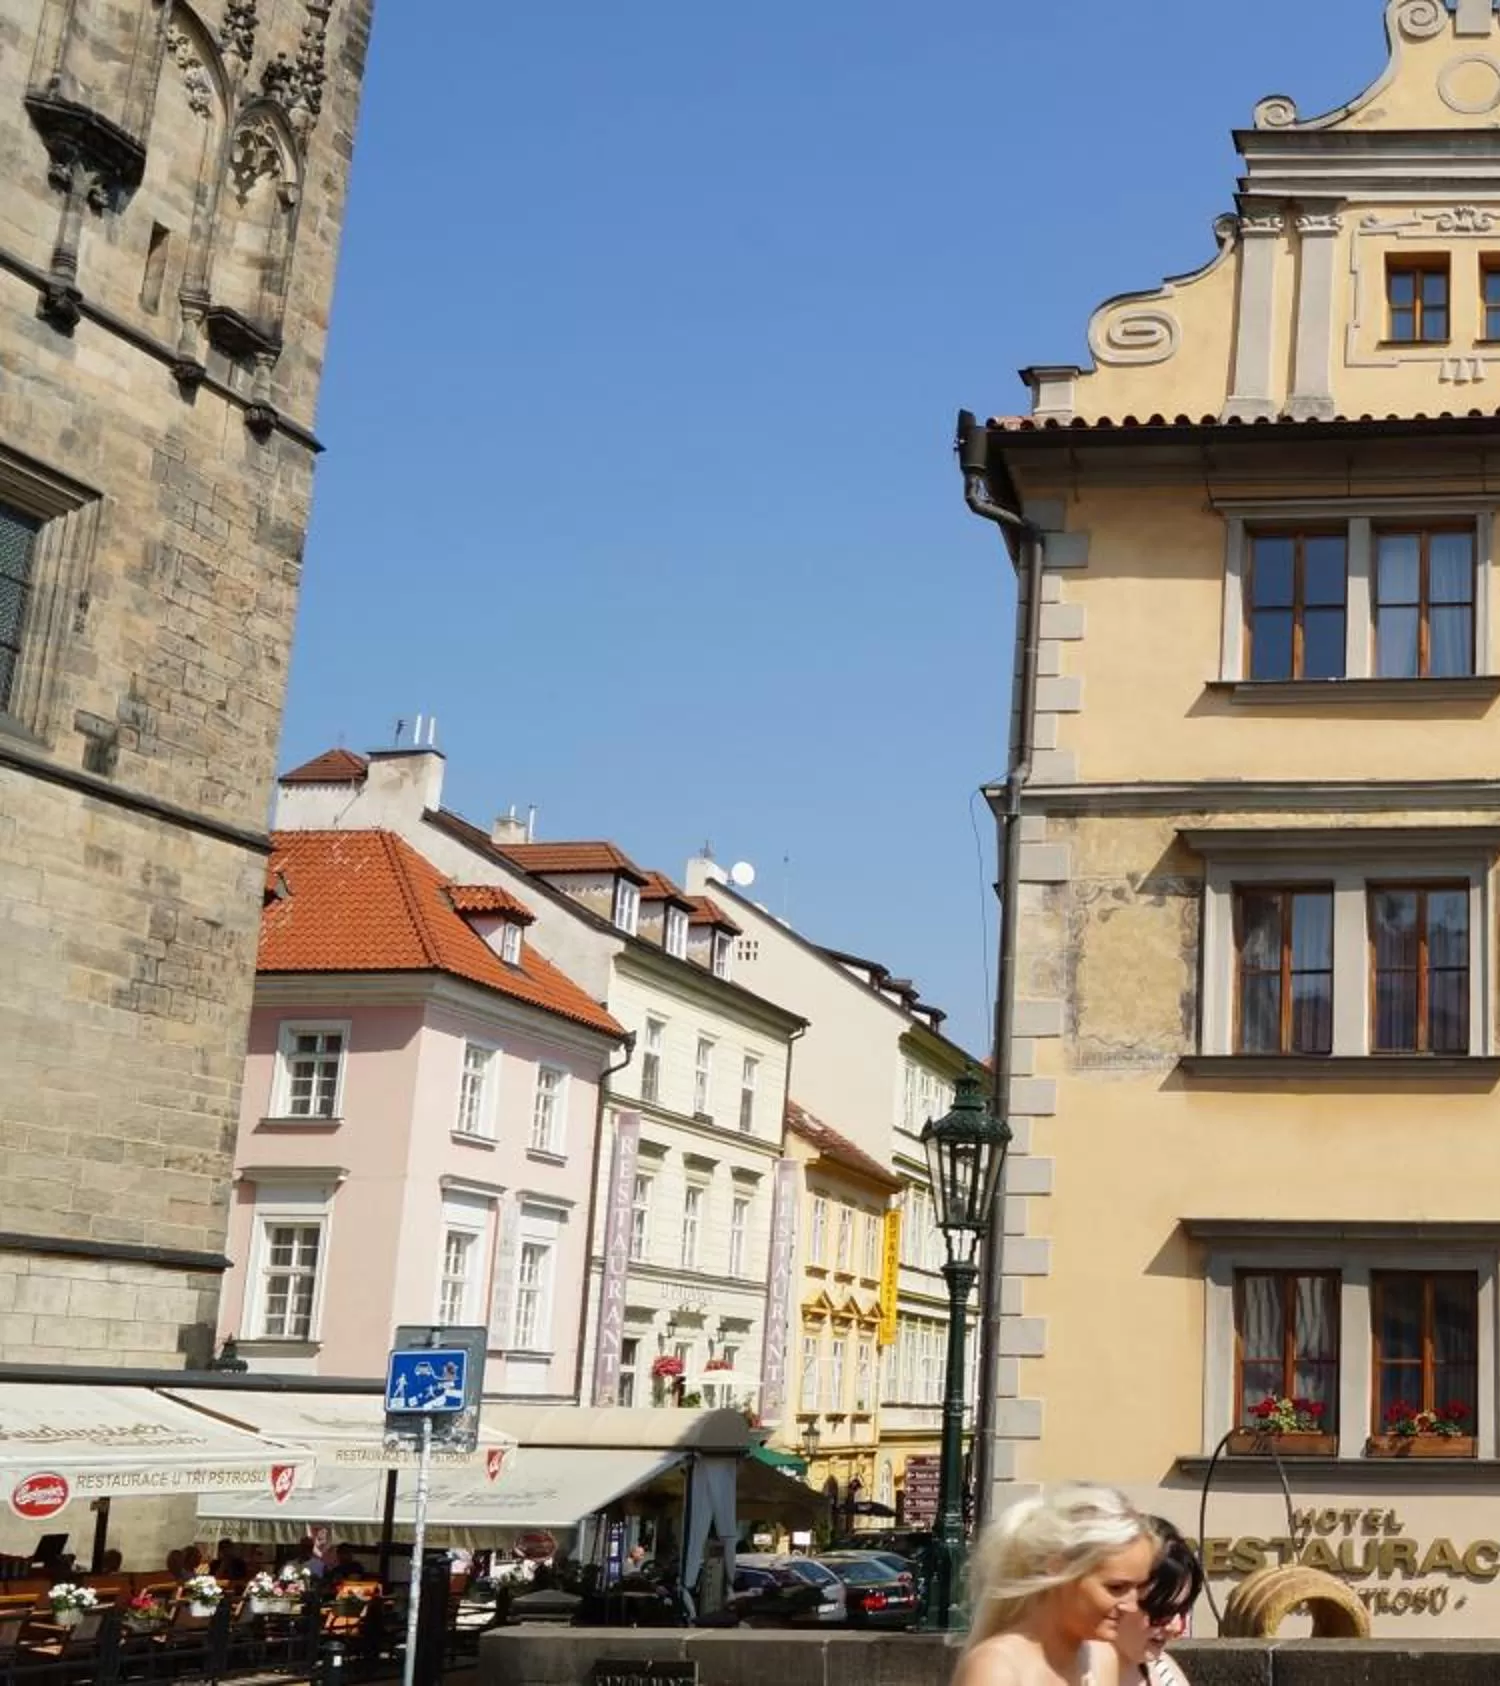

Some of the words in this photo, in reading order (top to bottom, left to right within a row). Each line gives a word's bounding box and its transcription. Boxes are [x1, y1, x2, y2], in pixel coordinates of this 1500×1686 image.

[603, 1136, 634, 1373] RESTAURANT
[76, 1471, 168, 1489] RESTAURACE
[172, 1472, 181, 1485] U
[1290, 1507, 1404, 1537] HOTEL
